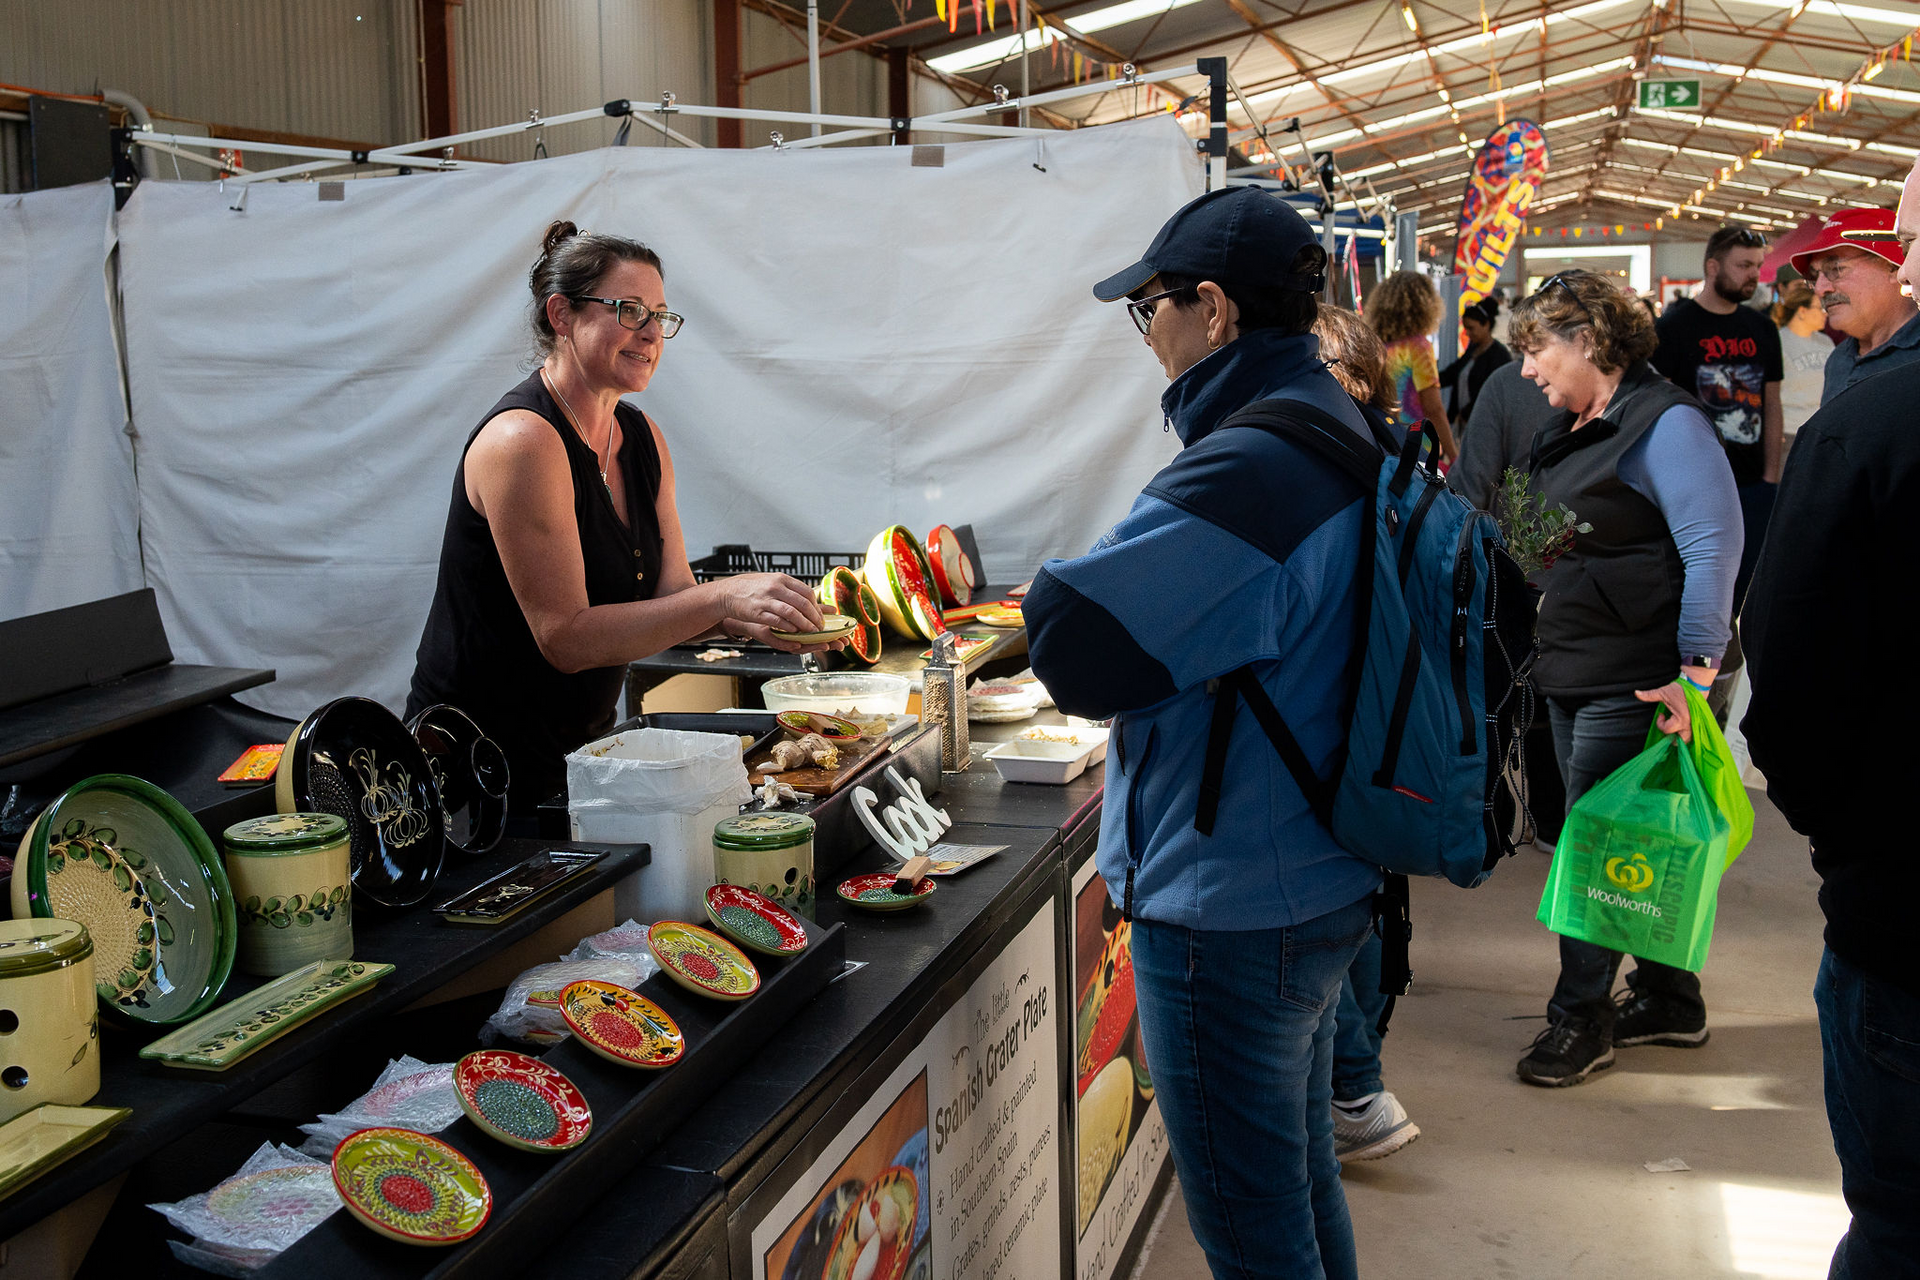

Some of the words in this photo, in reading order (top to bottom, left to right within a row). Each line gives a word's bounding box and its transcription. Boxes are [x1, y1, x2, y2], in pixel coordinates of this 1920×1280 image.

[1699, 335, 1757, 362] DIO
[850, 765, 952, 863] Cook
[1587, 886, 1662, 918] Woolworths
[935, 1060, 983, 1154] Spanish
[986, 1018, 1021, 1087] Grater
[1024, 986, 1047, 1041] Plate
[974, 1009, 989, 1044] The
[950, 1147, 974, 1199] Hand
[976, 1108, 1001, 1163] crafted
[1003, 1100, 1009, 1125] &
[1011, 1060, 1036, 1123] painted
[1029, 1125, 1050, 1176] purees
[951, 1216, 960, 1240] in
[961, 1163, 997, 1226] Southern
[998, 1131, 1018, 1175] Spain
[1004, 1203, 1030, 1257] ceramic
[1031, 1177, 1048, 1222] plate
[1109, 1144, 1139, 1247] Crafted
